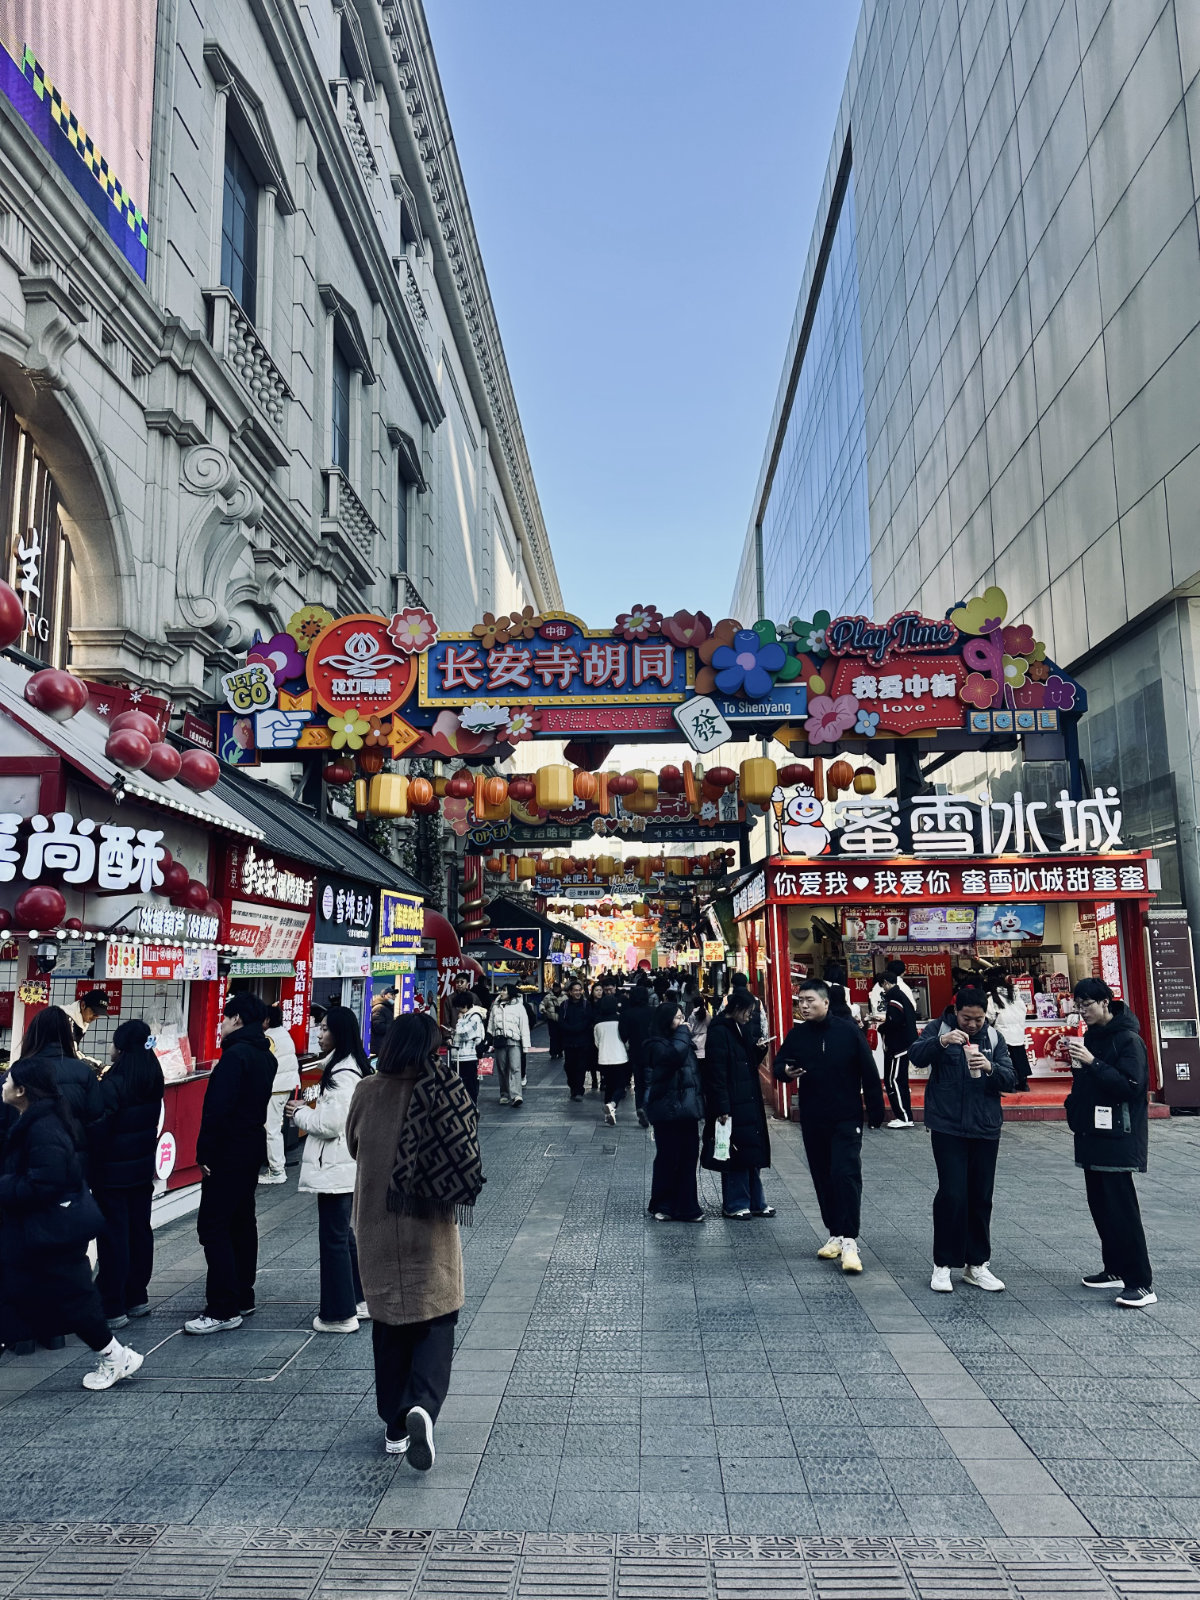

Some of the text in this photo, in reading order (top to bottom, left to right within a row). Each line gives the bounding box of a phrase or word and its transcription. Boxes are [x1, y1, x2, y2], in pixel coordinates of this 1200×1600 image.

[545, 626, 567, 638] 中街
[833, 612, 954, 660] Play Time
[437, 642, 675, 690] 长安寺胡同
[226, 668, 266, 691] LET'S
[851, 673, 958, 700] 我爱中街
[233, 682, 268, 709] GO
[548, 708, 670, 729] WELCOME
[722, 700, 792, 716] To Shenyang
[882, 703, 926, 714] Love
[692, 710, 724, 742] 發
[972, 711, 1057, 730] COOL
[592, 817, 607, 834] 我
[618, 815, 647, 833] 中街
[835, 786, 1124, 855] 蜜雪冰城
[475, 824, 509, 843] OPEN
[773, 872, 849, 896] 你爱我
[874, 870, 951, 896] 我爱你
[961, 865, 1146, 894] 蜜雪冰城甜蜜蜜
[336, 888, 373, 928] 雪绵豆沙
[143, 946, 160, 961] Mini
[904, 962, 946, 977] 雪冰城
[855, 978, 868, 991] 城
[159, 1142, 172, 1170] 芦
